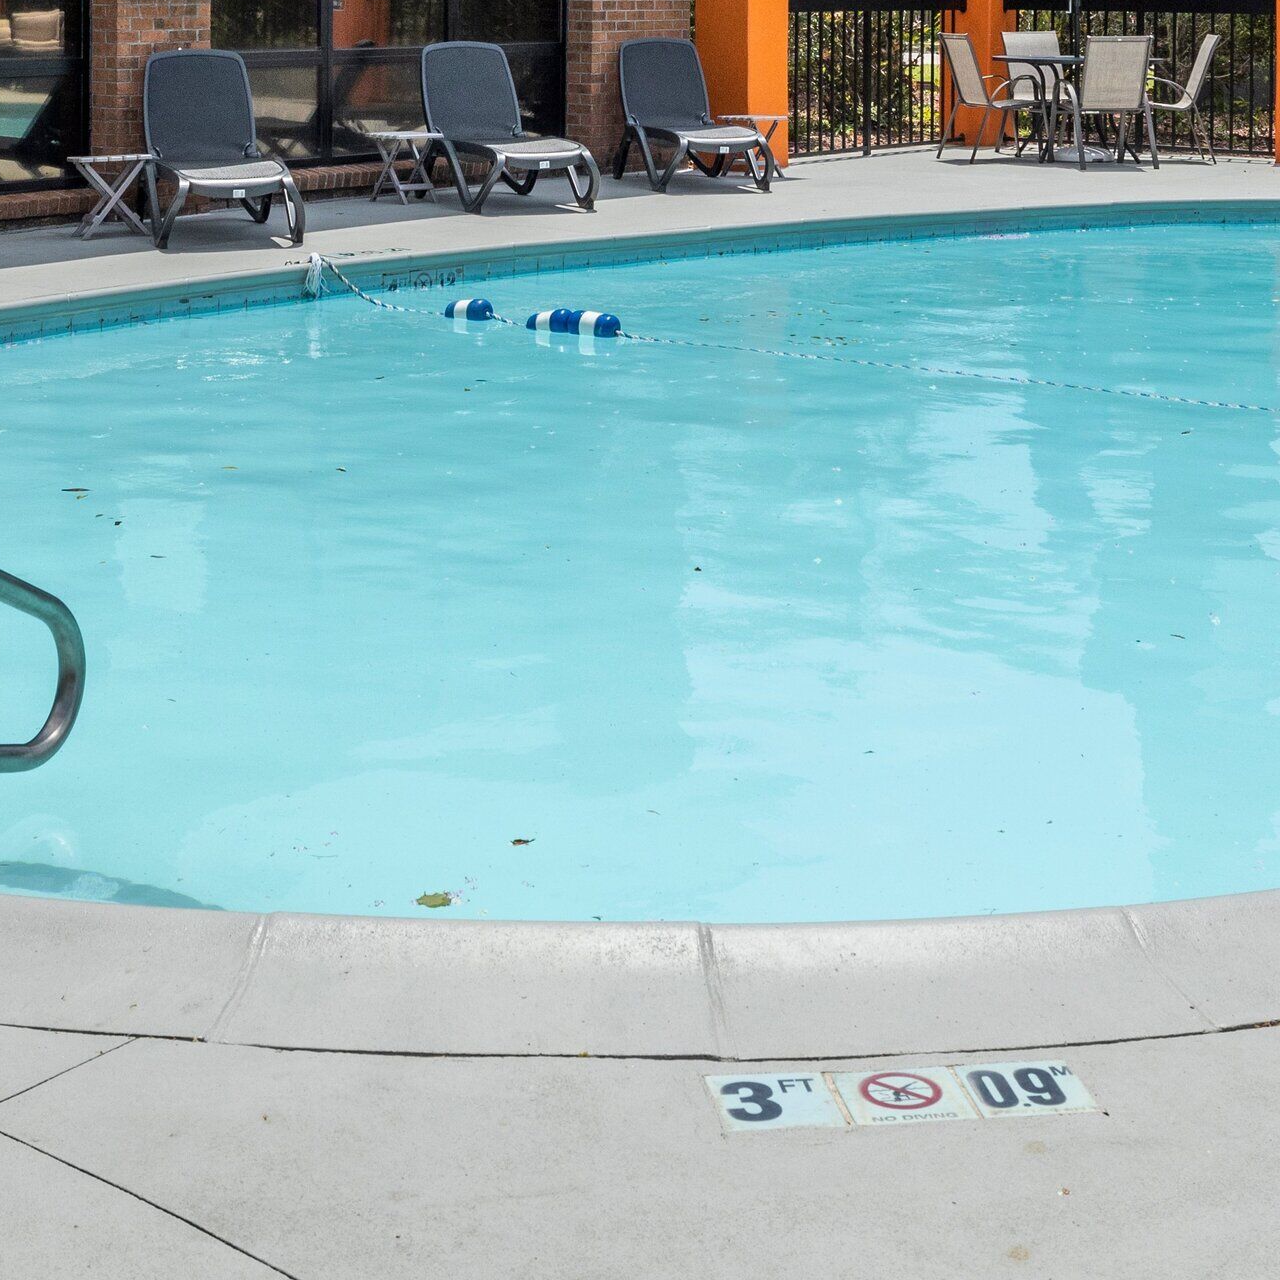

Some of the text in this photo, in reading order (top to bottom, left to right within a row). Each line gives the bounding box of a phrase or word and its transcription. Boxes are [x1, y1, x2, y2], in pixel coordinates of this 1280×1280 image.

[720, 1078, 815, 1122] 3 FT
[966, 1065, 1074, 1109] 0.9 M
[871, 1112, 959, 1123] NO DIVING
